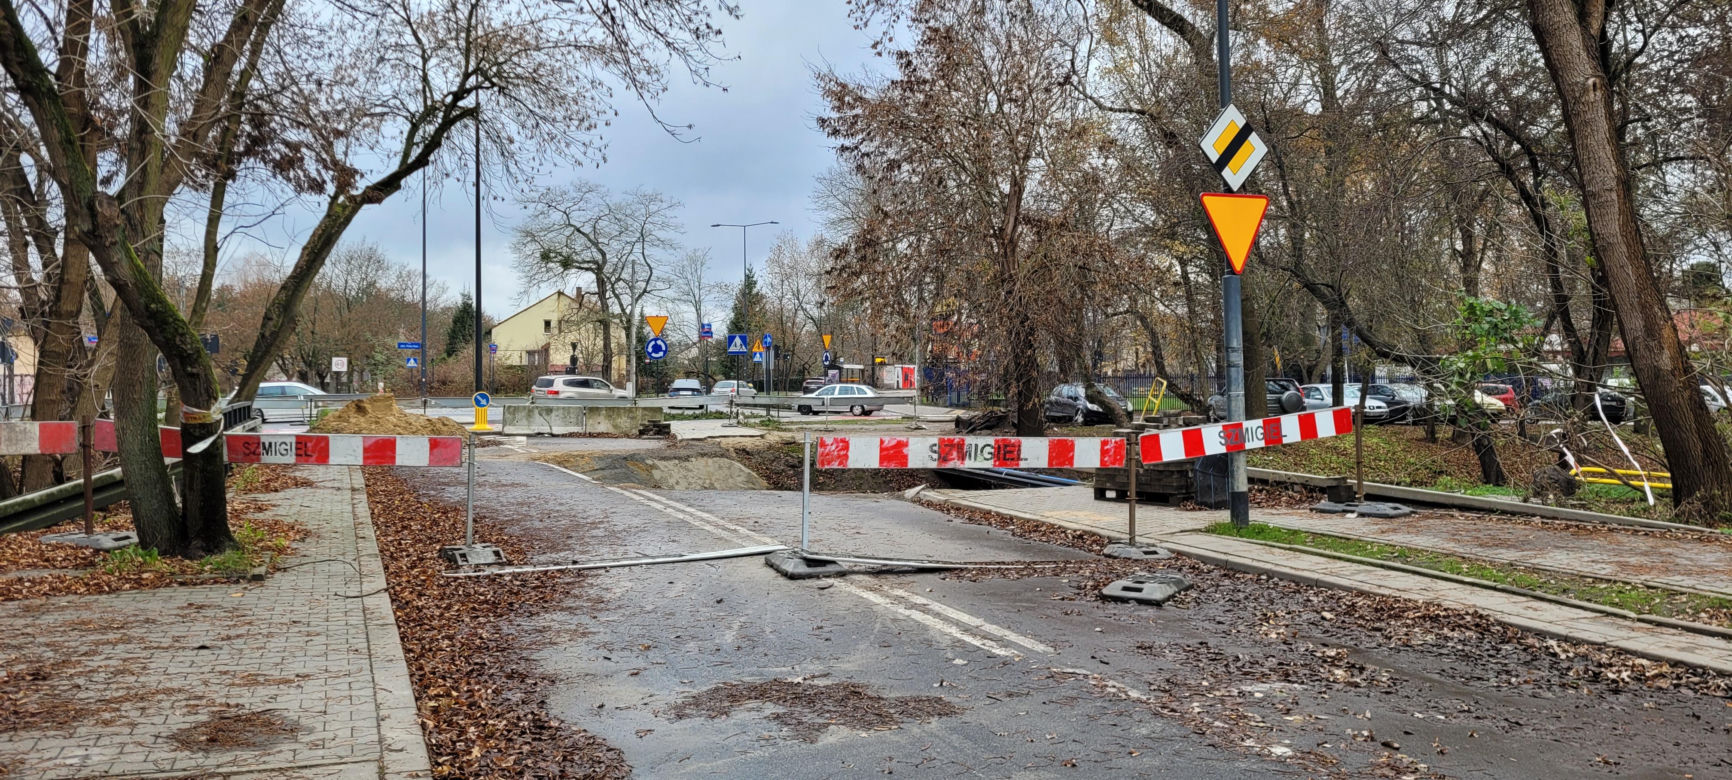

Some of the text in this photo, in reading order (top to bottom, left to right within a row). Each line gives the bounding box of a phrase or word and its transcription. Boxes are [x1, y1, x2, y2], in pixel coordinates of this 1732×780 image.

[1218, 423, 1287, 446] SZMIGIEL
[242, 441, 313, 457] SZMIGIEL
[928, 443, 1028, 462] SZMIGIEL
